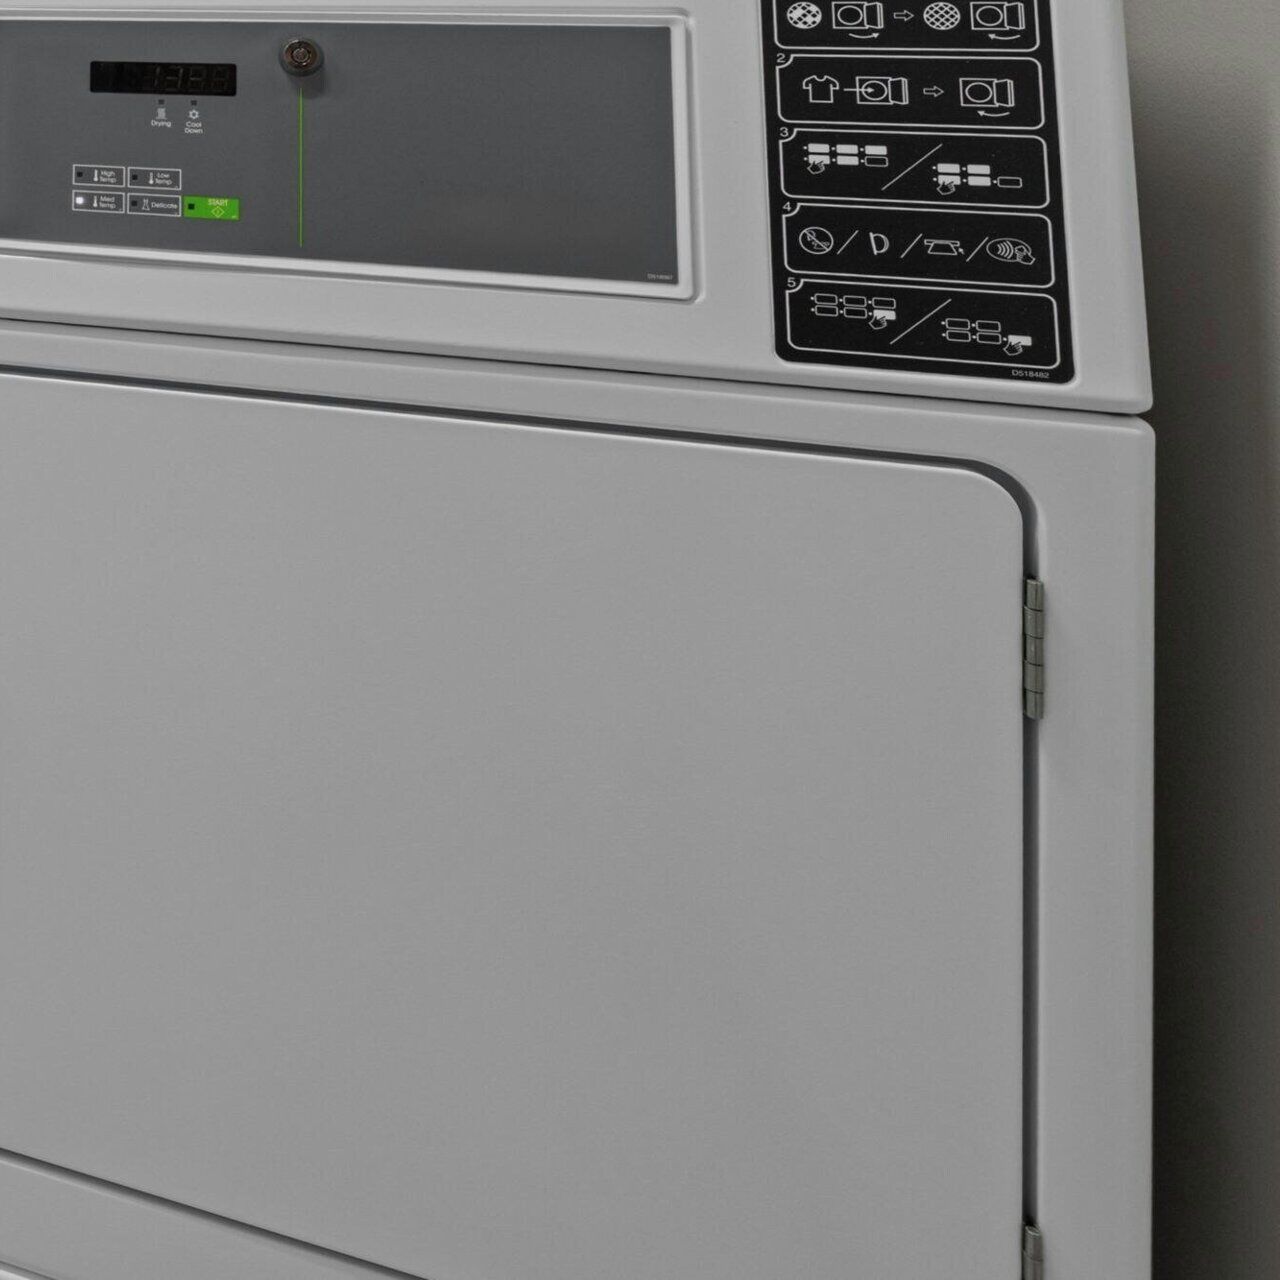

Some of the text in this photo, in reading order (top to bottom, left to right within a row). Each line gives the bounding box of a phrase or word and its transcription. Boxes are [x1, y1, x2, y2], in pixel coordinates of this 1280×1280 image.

[776, 52, 786, 63] 2
[150, 119, 172, 128] Drying
[779, 126, 790, 138] 3
[100, 170, 116, 178] High
[99, 176, 117, 184] Temp
[155, 178, 172, 186] Temp
[100, 195, 116, 203] Med
[207, 198, 229, 206] START
[99, 202, 116, 210] Temp
[151, 201, 178, 210] Delicate
[782, 201, 792, 211] 4
[786, 276, 796, 288] 5
